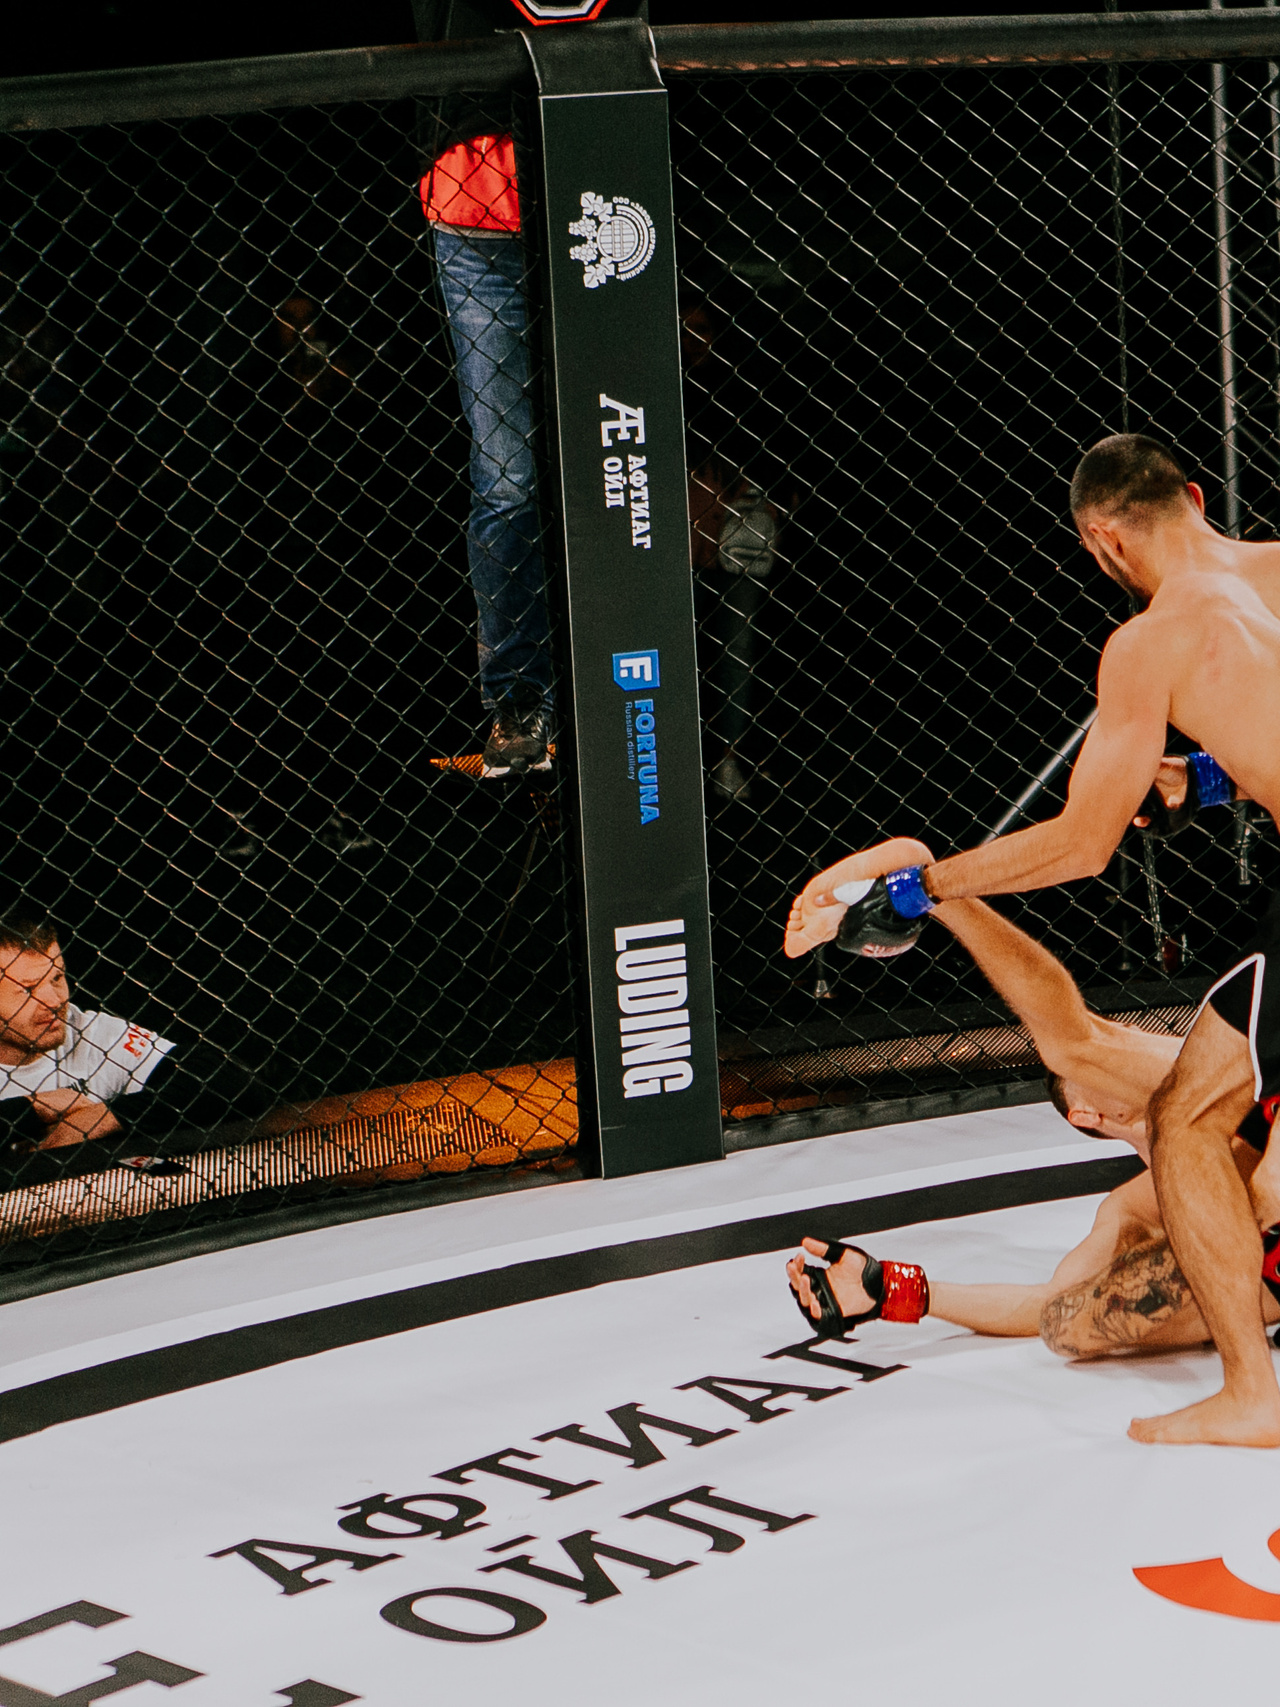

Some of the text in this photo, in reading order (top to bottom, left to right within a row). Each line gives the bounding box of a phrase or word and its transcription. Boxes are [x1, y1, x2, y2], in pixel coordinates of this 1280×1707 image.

[603, 456, 627, 509] ОЙЛ
[628, 454, 652, 549] АФТИАГ
[625, 701, 636, 781] Russian distillery
[634, 698, 660, 825] FORTUNA
[614, 919, 694, 1099] LUDING
[206, 1332, 913, 1597] АФТИАГ
[379, 1485, 819, 1643] ОЙЛ
